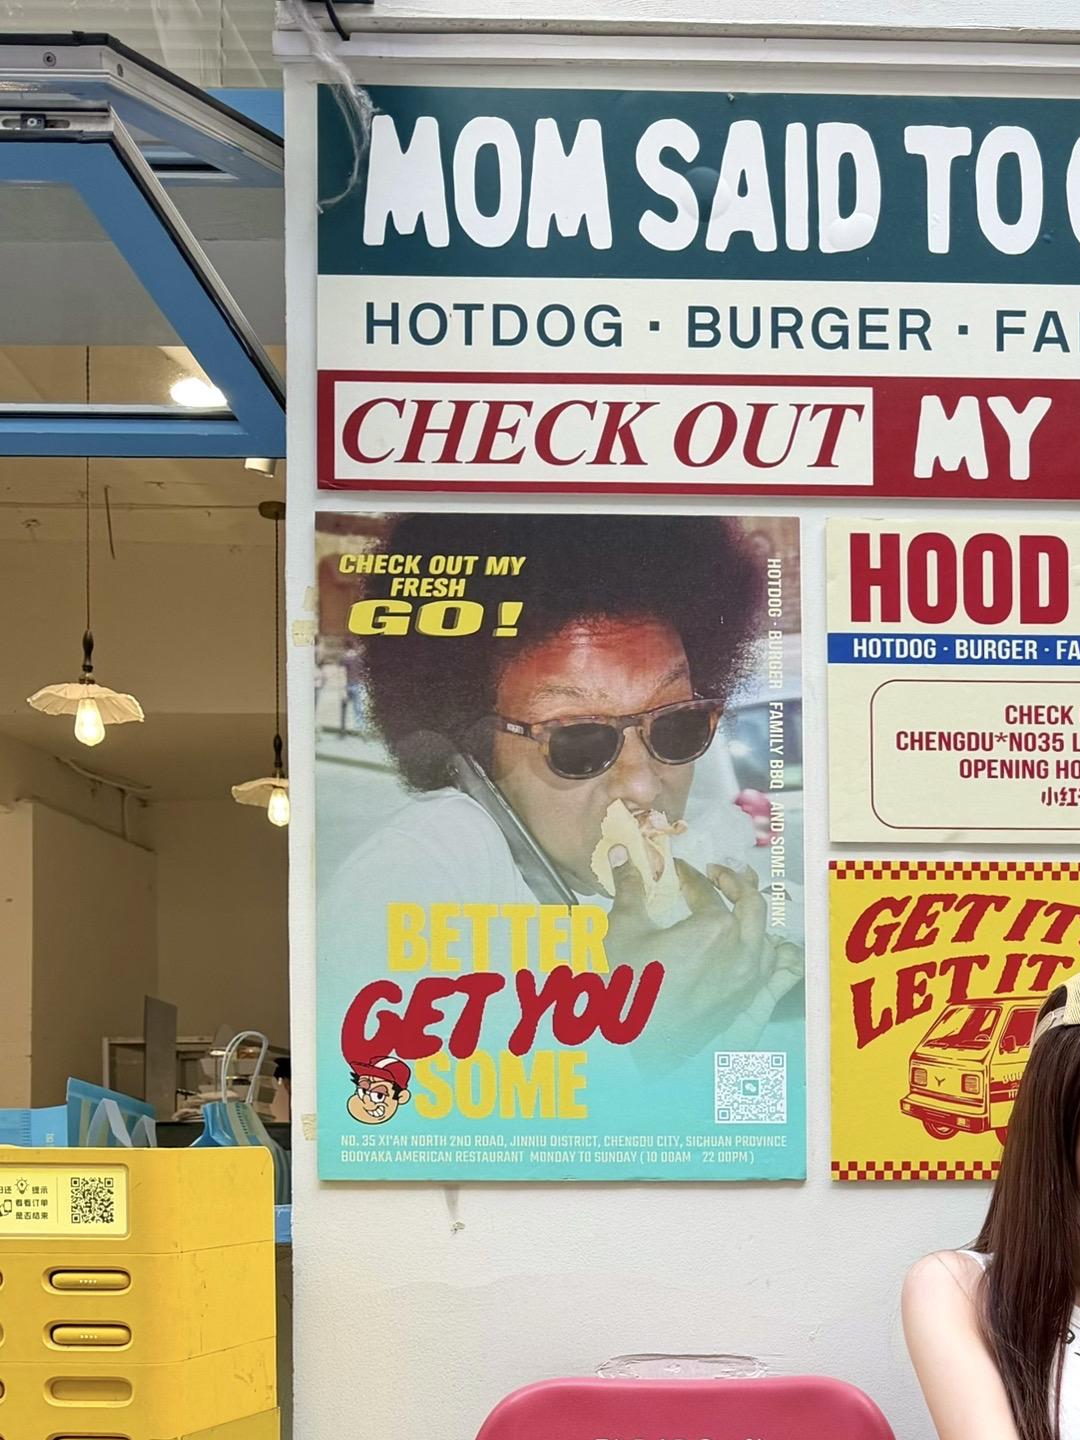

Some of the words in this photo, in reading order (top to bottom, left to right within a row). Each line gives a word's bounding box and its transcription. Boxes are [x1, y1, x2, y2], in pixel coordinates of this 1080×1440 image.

[363, 115, 612, 249] MOM
[636, 118, 881, 253] SAID
[904, 125, 1043, 255] TO
[364, 301, 624, 347] HOTDOG
[688, 305, 933, 352] BURGER
[341, 396, 660, 467] CHECK
[673, 400, 866, 469] OUT
[913, 394, 1053, 481] MY
[339, 554, 422, 575] CHECK
[429, 555, 479, 576] OUT
[485, 556, 526, 577] MY
[390, 577, 466, 597] FRESH
[767, 559, 782, 618] HOTDOG
[849, 531, 1070, 625] HOOD
[347, 598, 524, 638] GO!
[768, 630, 783, 689] BURGER
[853, 637, 936, 659] HOTDOG
[955, 639, 1038, 660] BURGER
[769, 702, 784, 755] FAMILY
[1004, 705, 1074, 726] CHECK
[769, 759, 784, 789] BBQ
[959, 758, 1050, 779] OPENING
[770, 801, 785, 832] AND
[771, 836, 786, 878] SOME
[771, 882, 786, 927] DRINK
[845, 893, 1011, 963] GET
[386, 902, 610, 974] BETTER
[340, 971, 505, 1063] GET
[508, 960, 665, 1057] YOU
[850, 953, 990, 1049] LET
[993, 952, 1075, 995] IT
[414, 1050, 589, 1120] SOME
[341, 1135, 360, 1147] NO.
[362, 1135, 376, 1147] 35
[411, 1135, 447, 1147] NORTH
[449, 1135, 472, 1147] 2ND
[510, 1135, 547, 1147] JINNIU
[604, 1135, 652, 1148] CHENGDU
[686, 1135, 732, 1148] SICHUAN
[736, 1135, 787, 1148] PROVINCE
[341, 1151, 393, 1163] BOOYAKA
[395, 1151, 452, 1163] AMERICAN
[455, 1151, 524, 1163] RESTAURANT
[530, 1151, 577, 1163] MONDAY
[580, 1151, 591, 1163] TO
[594, 1151, 637, 1163] SUNDAY
